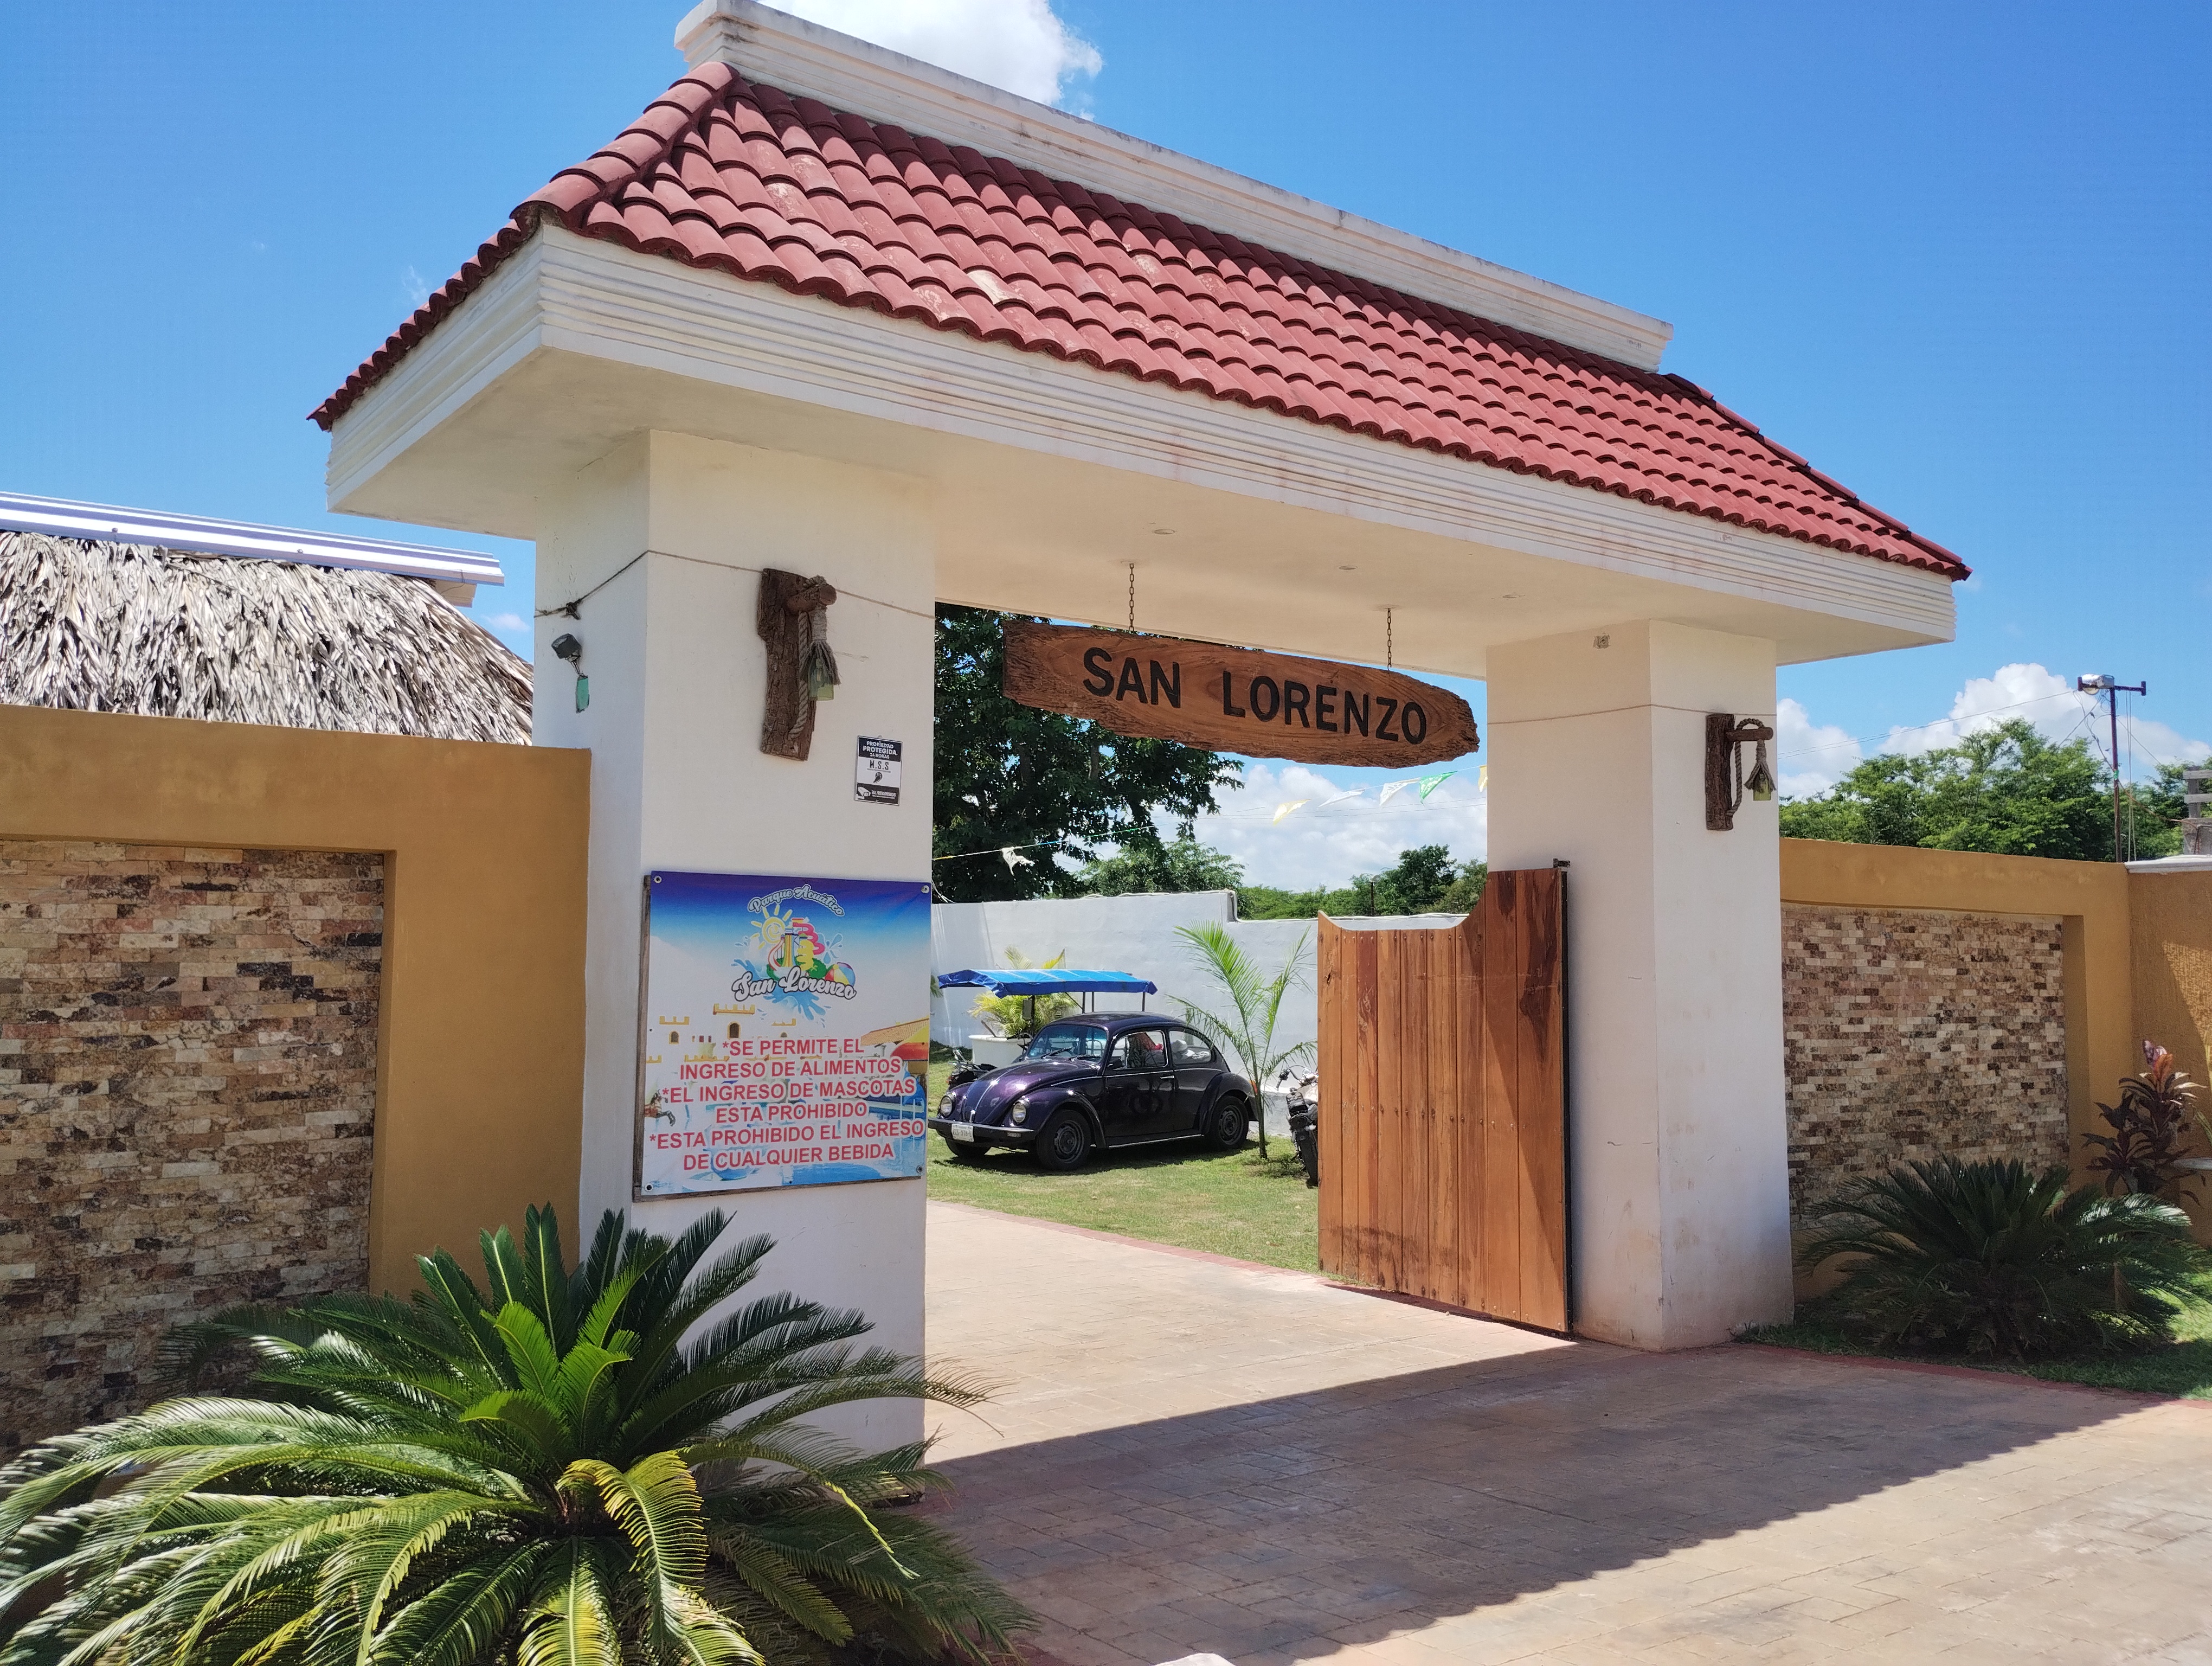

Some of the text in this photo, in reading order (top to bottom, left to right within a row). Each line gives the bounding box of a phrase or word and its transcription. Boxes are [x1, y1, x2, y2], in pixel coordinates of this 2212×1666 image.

[1083, 647, 1427, 745] SAN LORENZO
[863, 745, 897, 755] PROTEGIDA
[866, 741, 894, 749] PROPIEDAD
[870, 759, 889, 770] M.S.S
[748, 885, 844, 915] Parque Acuático
[732, 966, 857, 1002] San Lorenzo
[760, 1039, 838, 1055] PERMITE
[844, 1038, 864, 1053] EL
[680, 1058, 901, 1080] INGRESO DE ALIMENTOS
[700, 1084, 784, 1101] INGRESO
[790, 1083, 813, 1098] DE
[821, 1079, 915, 1098] MASCOTAS
[716, 1102, 867, 1124] ESTA PROHIBIDO
[711, 1125, 814, 1146] PROHIBIDO
[821, 1124, 841, 1140] EL
[847, 1120, 923, 1138] INGRESO
[684, 1143, 893, 1170] DE CUALQUIER BEBIDA
